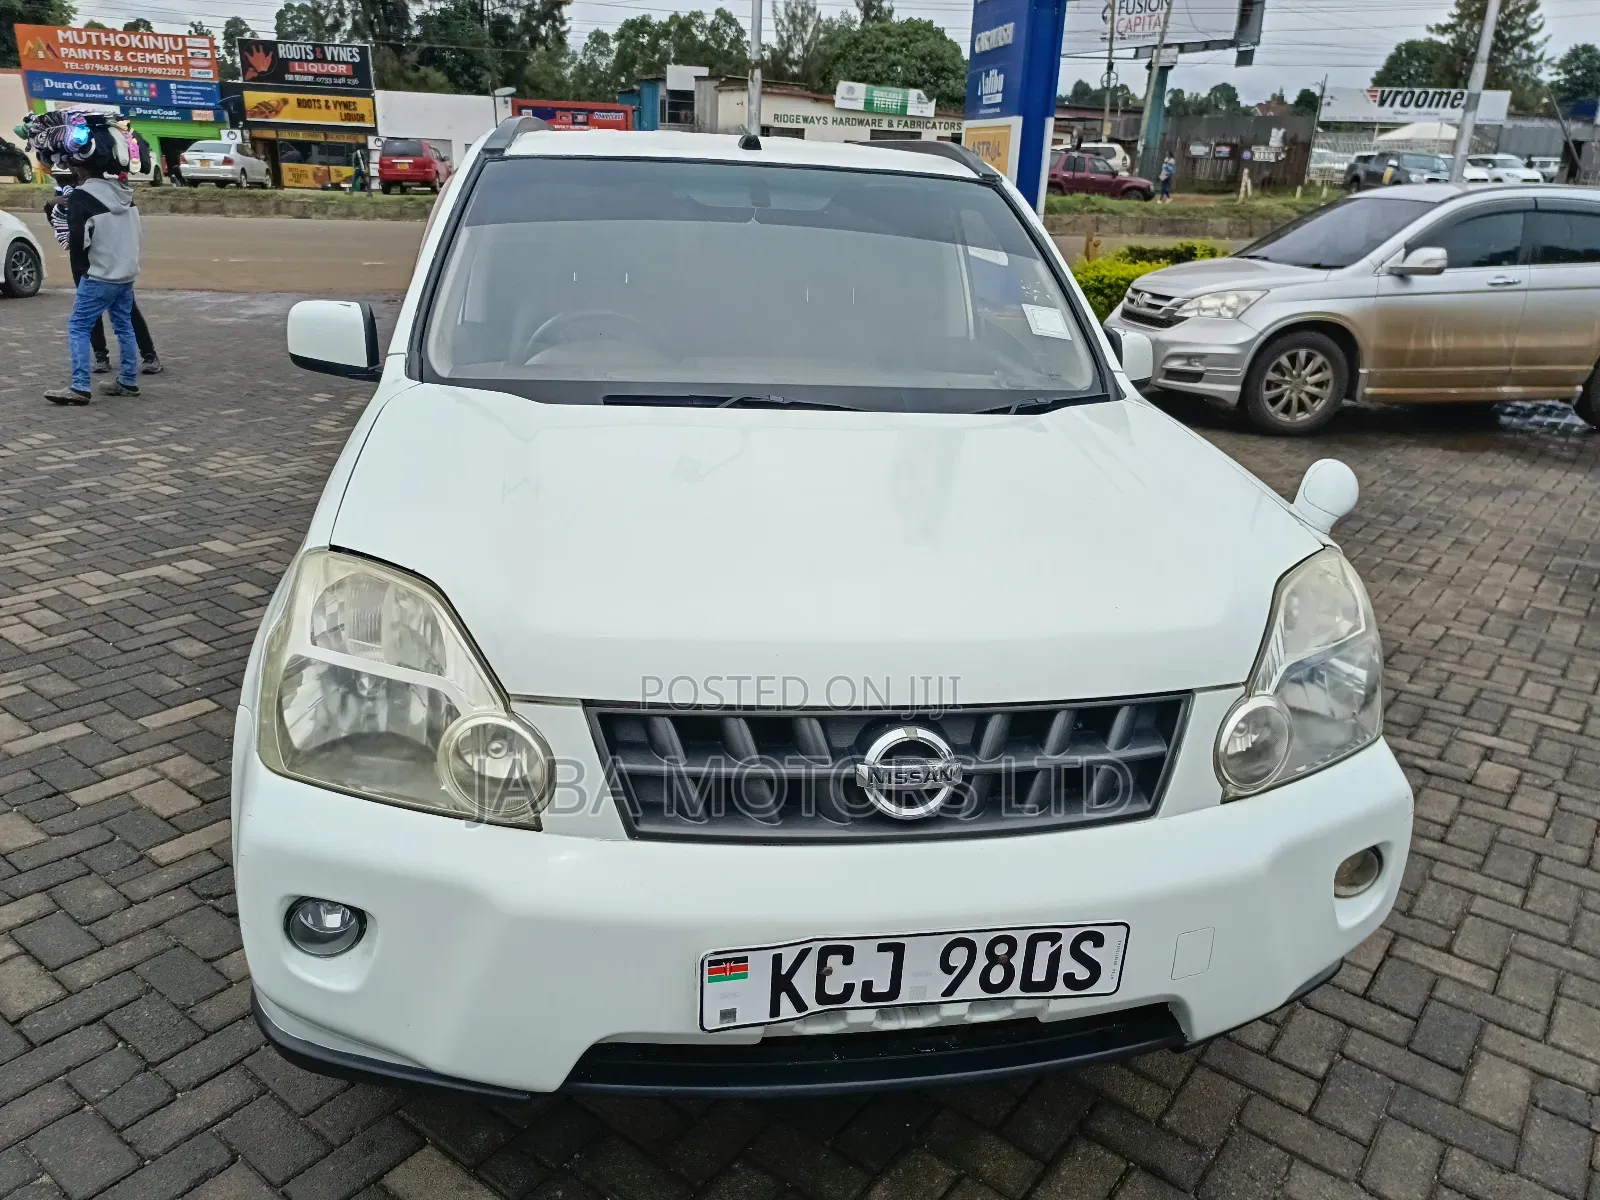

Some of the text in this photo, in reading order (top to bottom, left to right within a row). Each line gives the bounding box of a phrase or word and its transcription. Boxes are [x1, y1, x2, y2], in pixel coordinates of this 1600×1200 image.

[1116, 14, 1163, 36] CAPITA
[57, 30, 184, 53] MUTHOKINJU
[60, 47, 185, 65] PAINTS & CEMENT
[277, 43, 360, 62] ROOTS & VYNES
[295, 62, 347, 74] LIQUOR
[43, 78, 102, 91] DuraCoat
[296, 98, 358, 111] ROOTS & VYNES
[1376, 89, 1467, 109] vroome
[135, 107, 179, 116] DuraCoat
[340, 111, 366, 122] LIQUOR
[773, 113, 962, 131] RIDGEWAYS HARDWARE & FABRICATORS
[867, 766, 954, 785] NISSAN
[769, 930, 1105, 1018] KCJ 980S
